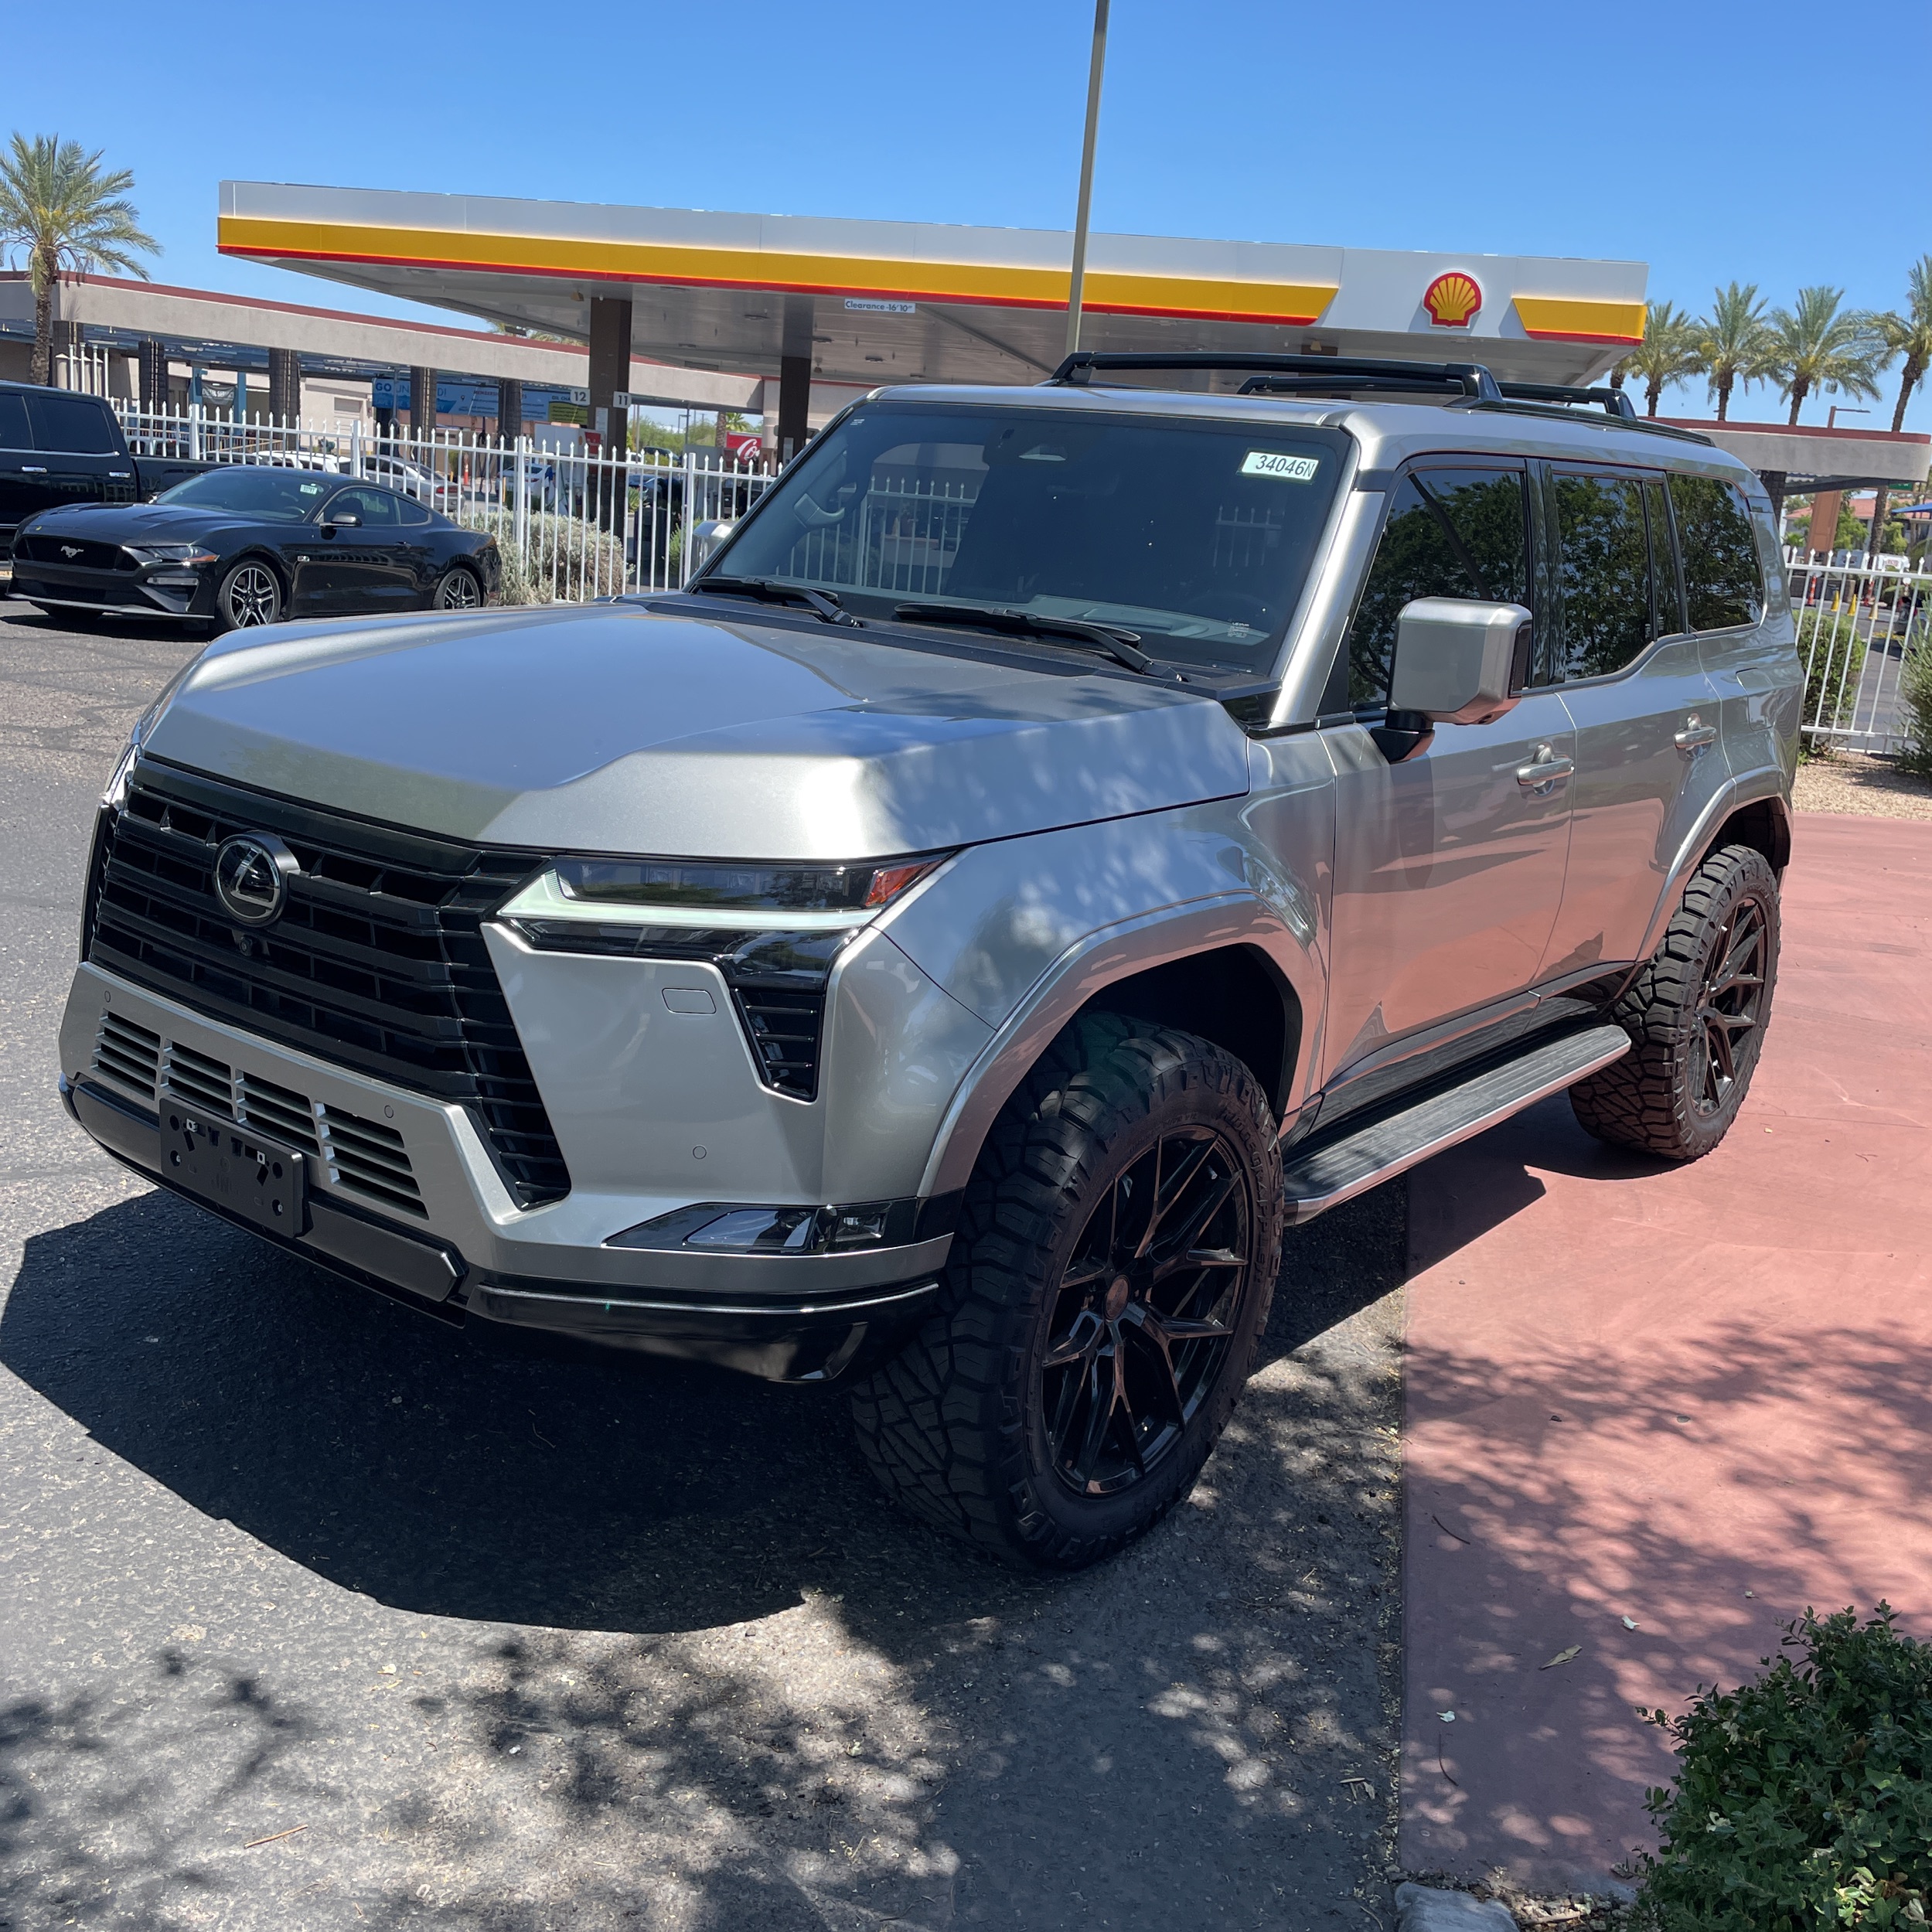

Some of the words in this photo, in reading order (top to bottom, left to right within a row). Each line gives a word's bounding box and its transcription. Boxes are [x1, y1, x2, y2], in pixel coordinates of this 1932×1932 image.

[845, 300, 885, 310] Clearance
[375, 382, 392, 392] GO
[574, 391, 587, 402] 12
[618, 395, 629, 406] 11
